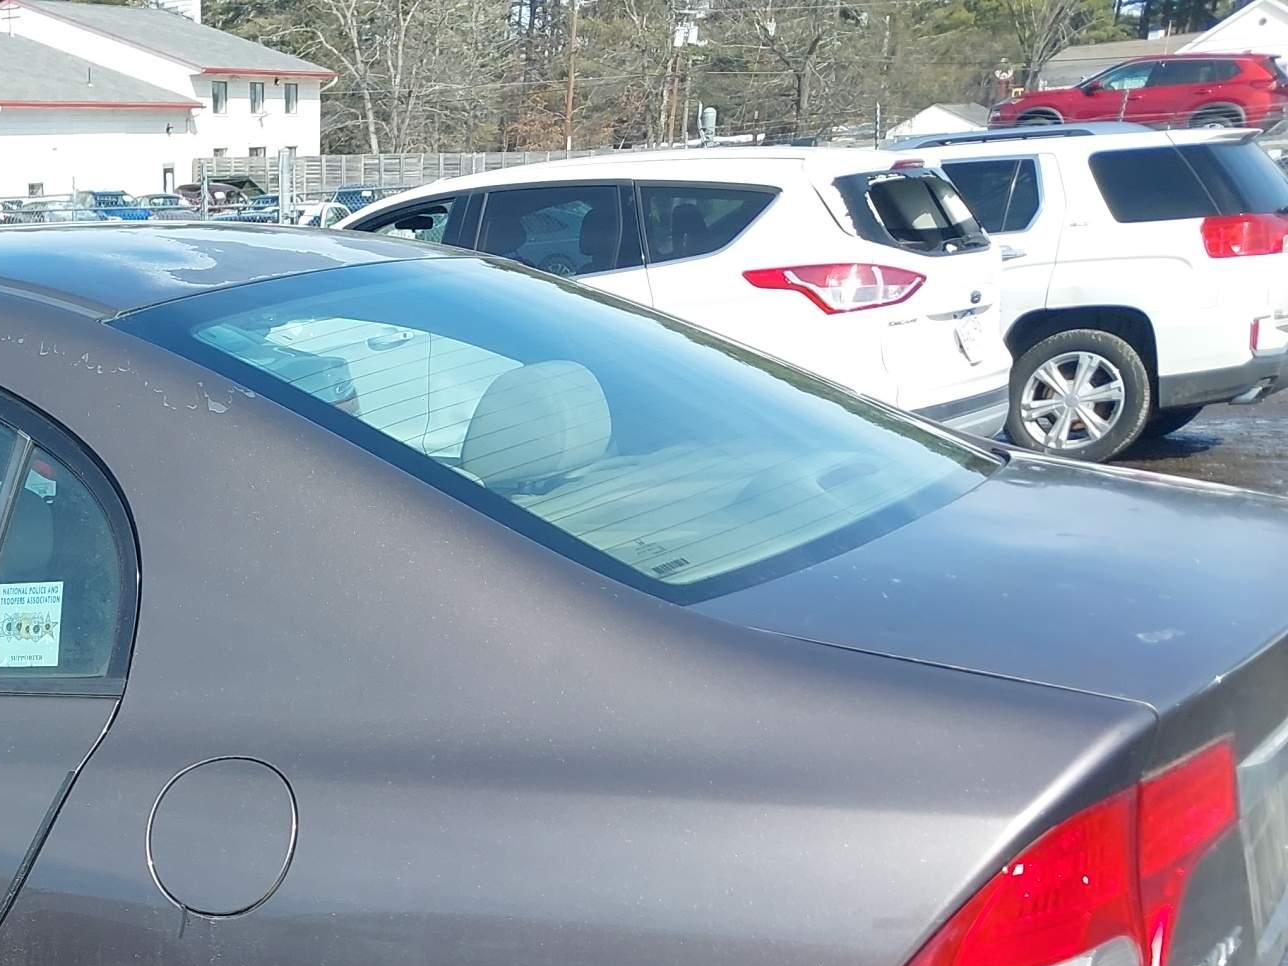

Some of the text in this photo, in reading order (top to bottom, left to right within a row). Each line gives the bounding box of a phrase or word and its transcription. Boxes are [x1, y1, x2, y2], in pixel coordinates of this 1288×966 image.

[2, 585, 59, 596] NATIONAL POLICE AND
[0, 596, 60, 606] TROOPERS ASSOCIATION
